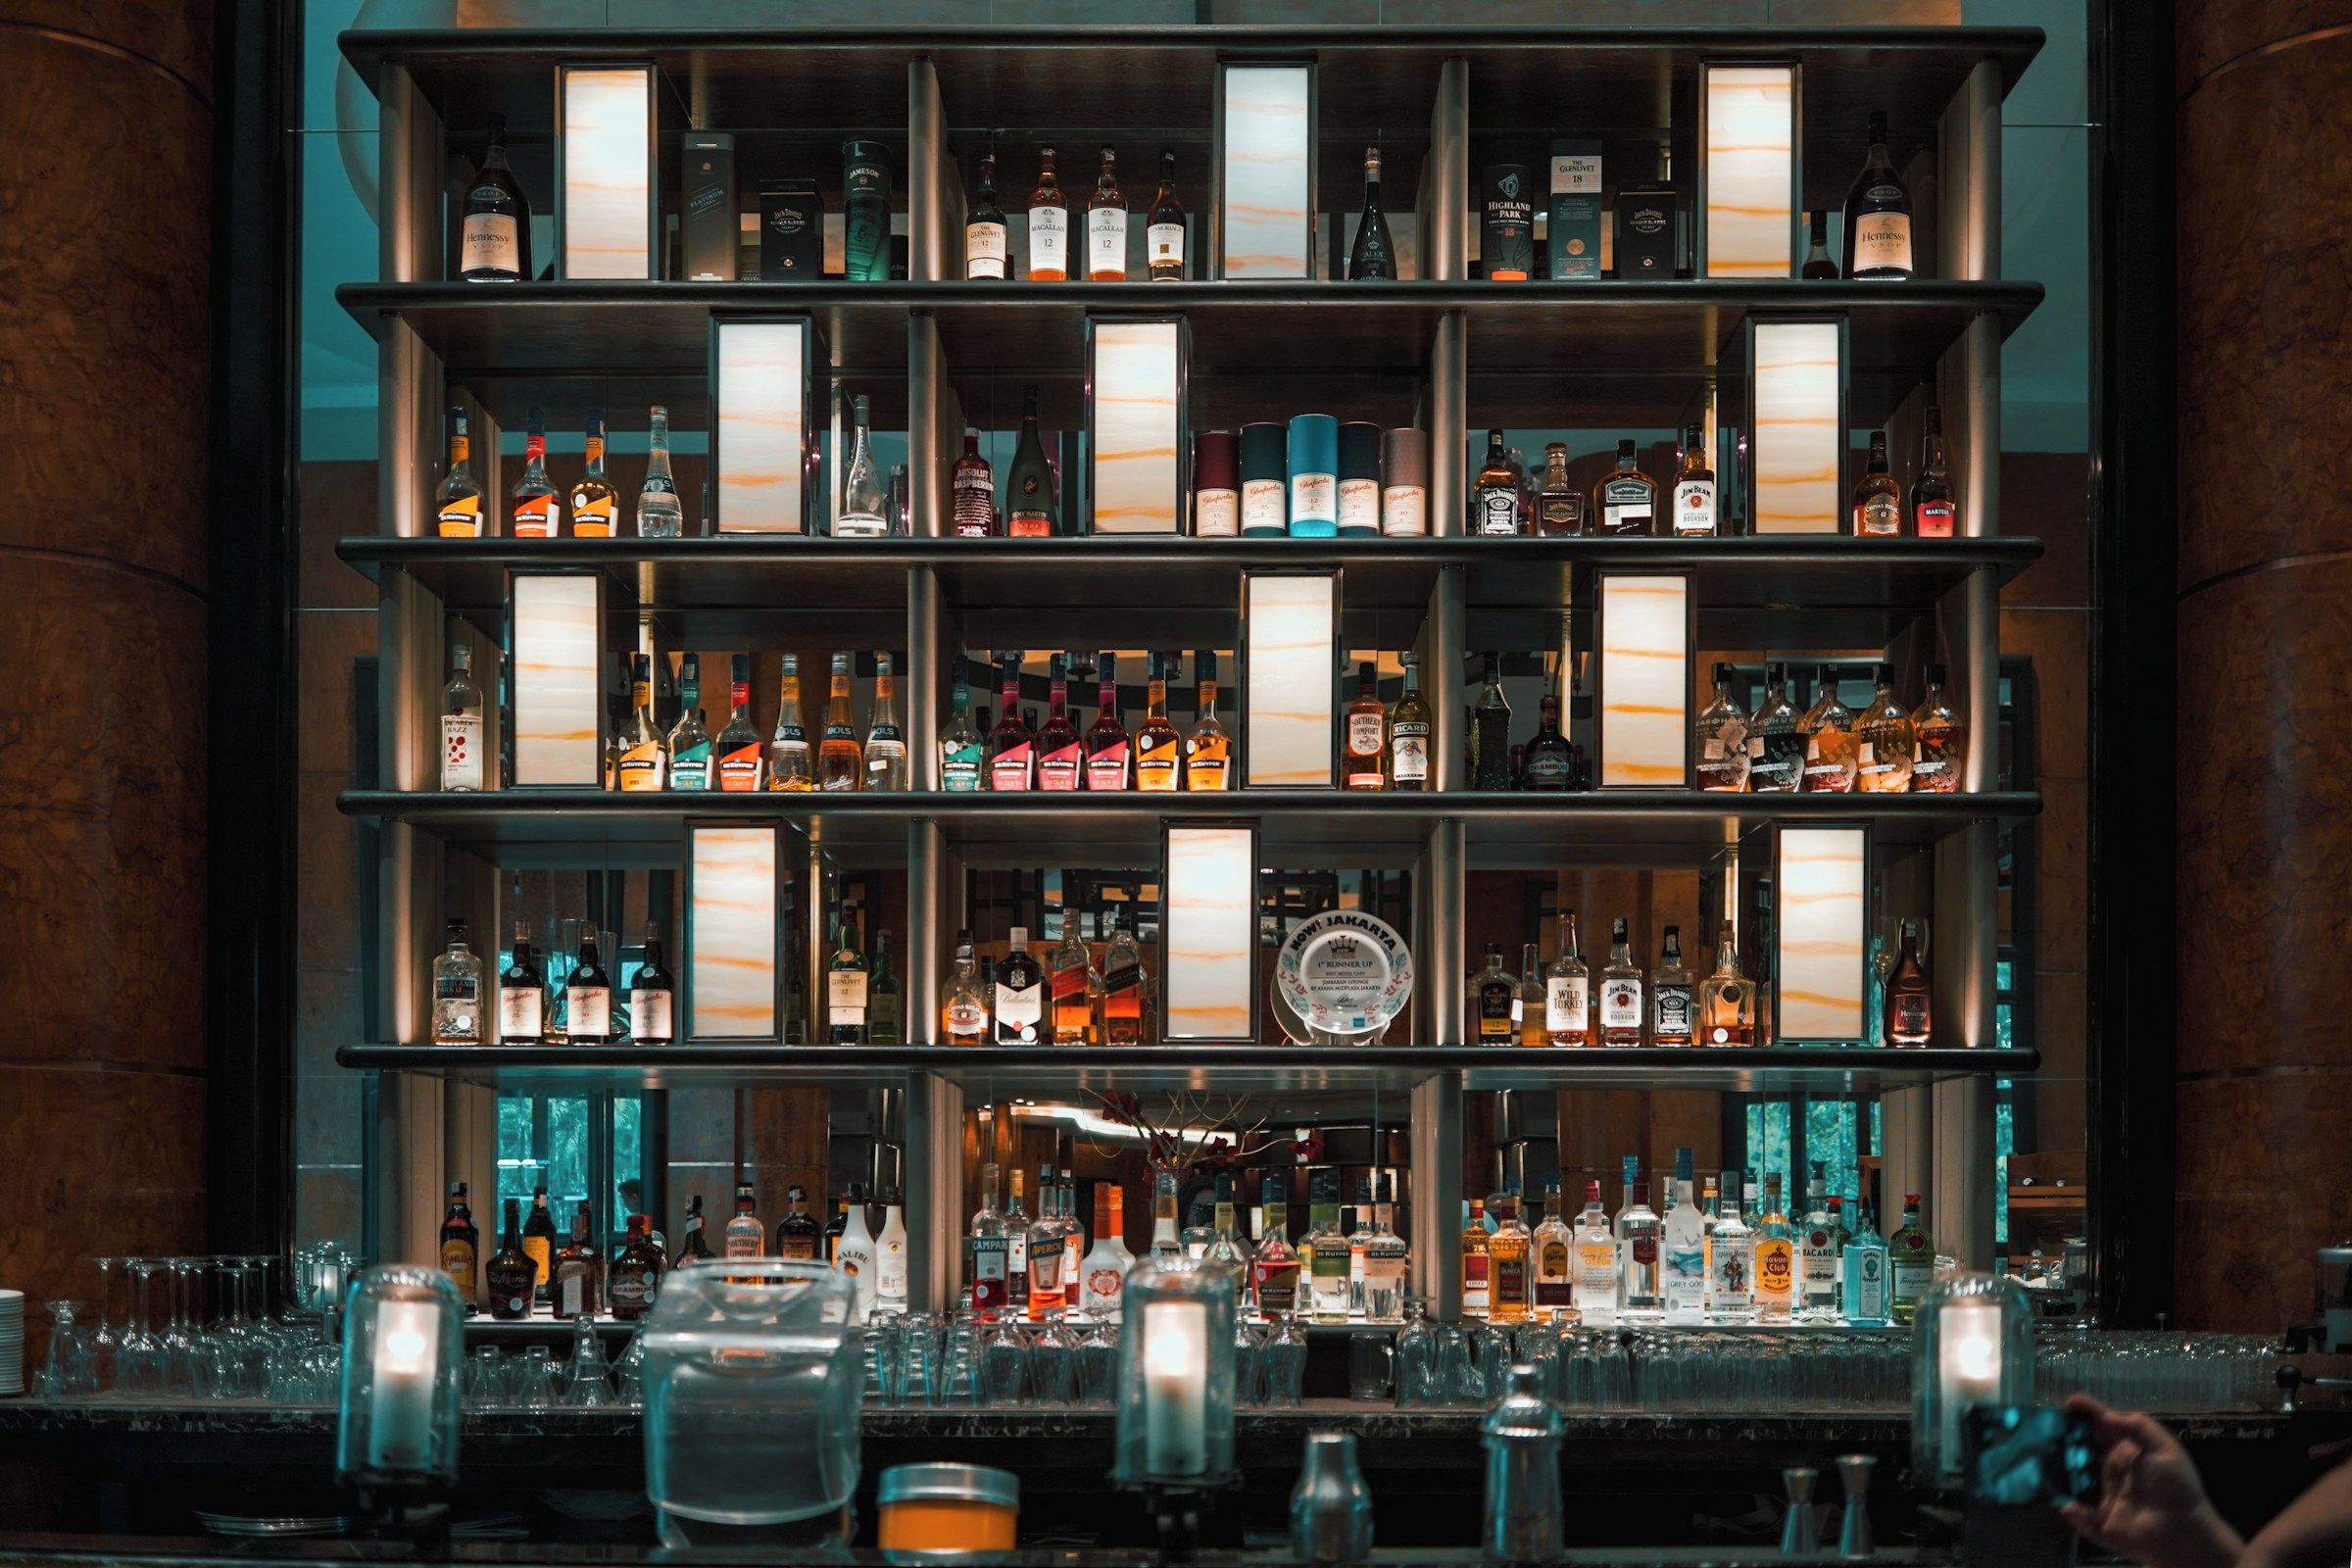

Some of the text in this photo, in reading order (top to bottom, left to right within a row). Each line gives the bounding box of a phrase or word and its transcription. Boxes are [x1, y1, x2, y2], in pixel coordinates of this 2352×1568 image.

[849, 168, 879, 179] JAMESON
[1559, 165, 1595, 173] GLENLIVET
[1573, 174, 1583, 183] 18
[1488, 201, 1531, 211] HIGHLAND
[1499, 210, 1522, 219] PARK
[1031, 224, 1065, 233] MACALLAN
[1091, 224, 1125, 234] MACALLAN
[1504, 226, 1515, 236] 18
[466, 232, 511, 246] Hennessy
[1862, 231, 1906, 243] Hennessy
[1044, 238, 1054, 248] 12
[1102, 239, 1111, 249] 12
[956, 468, 989, 479] ABSOLUT
[1682, 486, 1711, 499] JIM BEAM
[1866, 504, 1884, 513] CHIVAS
[1351, 716, 1380, 727] SOUTHERN
[827, 726, 852, 735] BOLS
[1352, 726, 1379, 736] COMFORT
[1395, 723, 1427, 733] RICARD
[1290, 915, 1396, 952] NOW! JAKARTA
[1558, 989, 1581, 1000] WILD
[1608, 983, 1638, 997] JIM BEAM
[1554, 999, 1584, 1010] TURKEY
[1900, 1010, 1927, 1019] Hennessy
[973, 1241, 1008, 1250] CAMPARI
[1032, 1244, 1061, 1254] APEROL
[837, 1250, 869, 1263] MALIBU
[1769, 1263, 1786, 1272] Club
